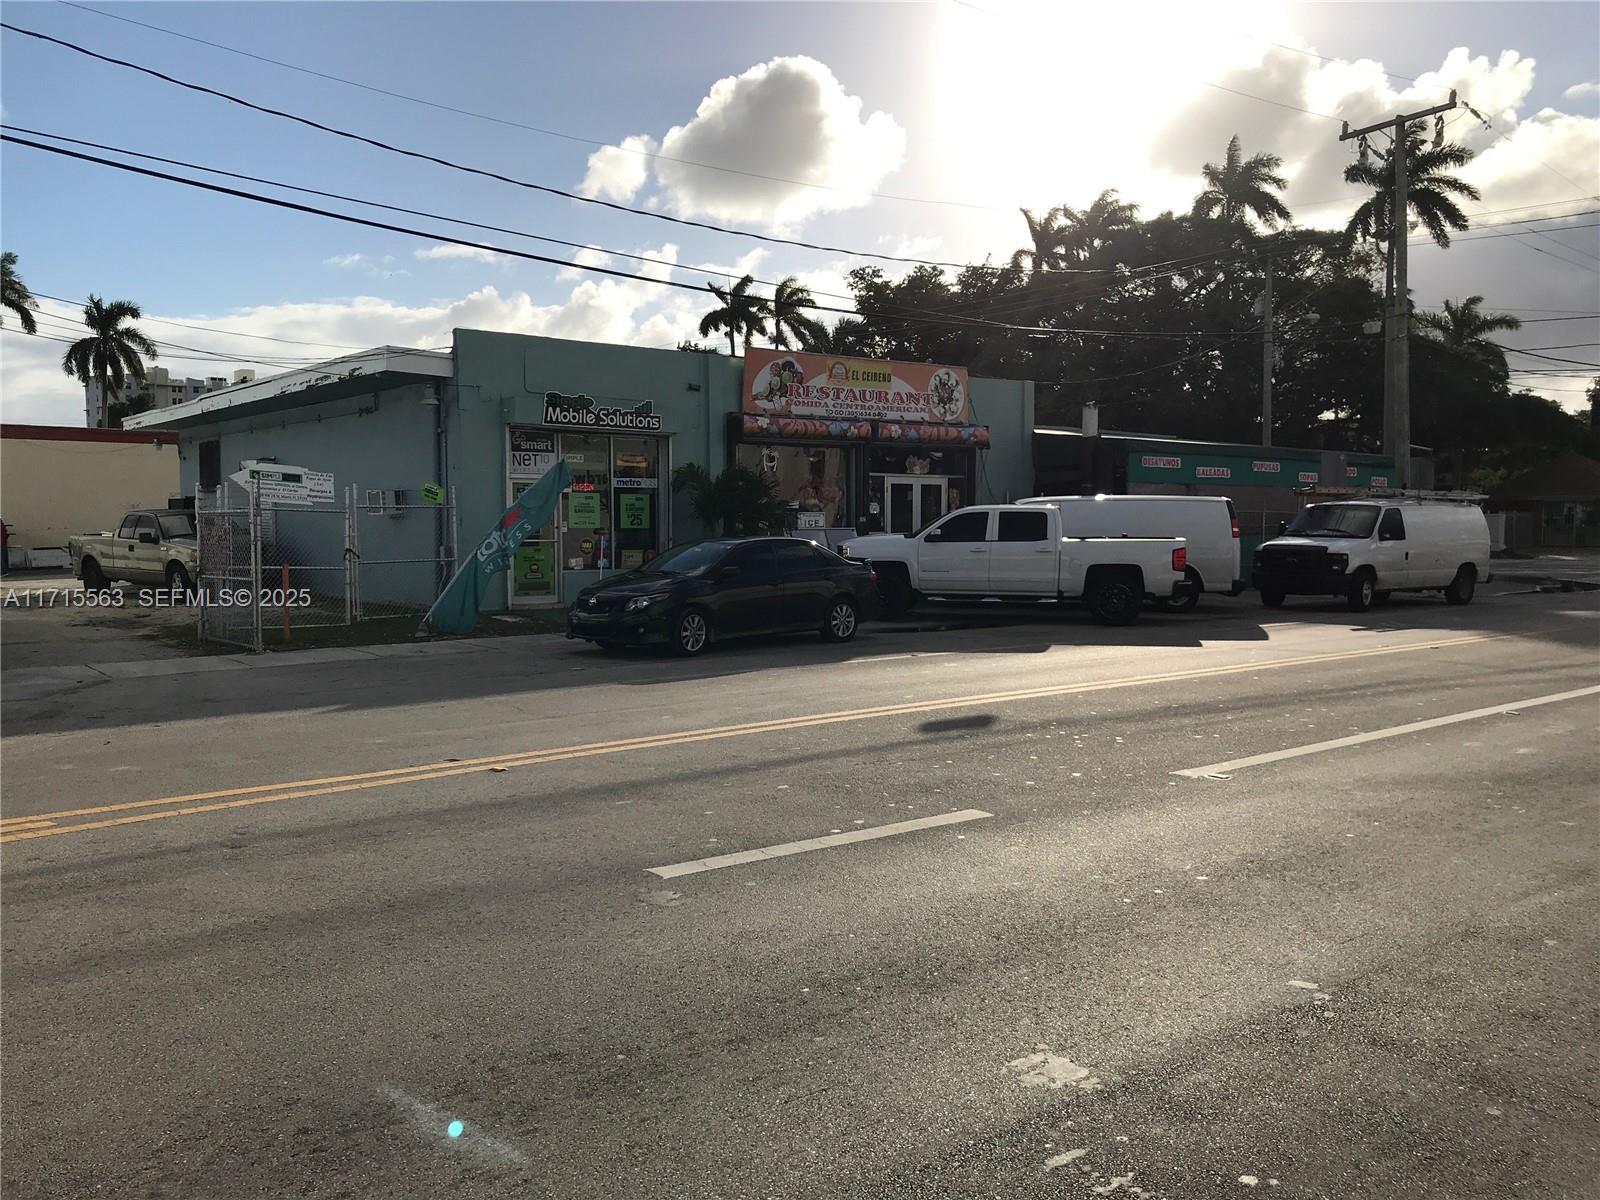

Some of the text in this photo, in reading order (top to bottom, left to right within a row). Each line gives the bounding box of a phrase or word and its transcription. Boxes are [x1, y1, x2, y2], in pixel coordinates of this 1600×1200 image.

[852, 370, 860, 381] EL
[786, 383, 934, 407] RESTAURANT
[785, 398, 829, 409] COMIDA
[547, 407, 661, 430] Mobile Solutions
[511, 433, 527, 446] Go
[520, 440, 553, 451] smart
[616, 479, 642, 487] metro
[804, 519, 820, 528] ICE
